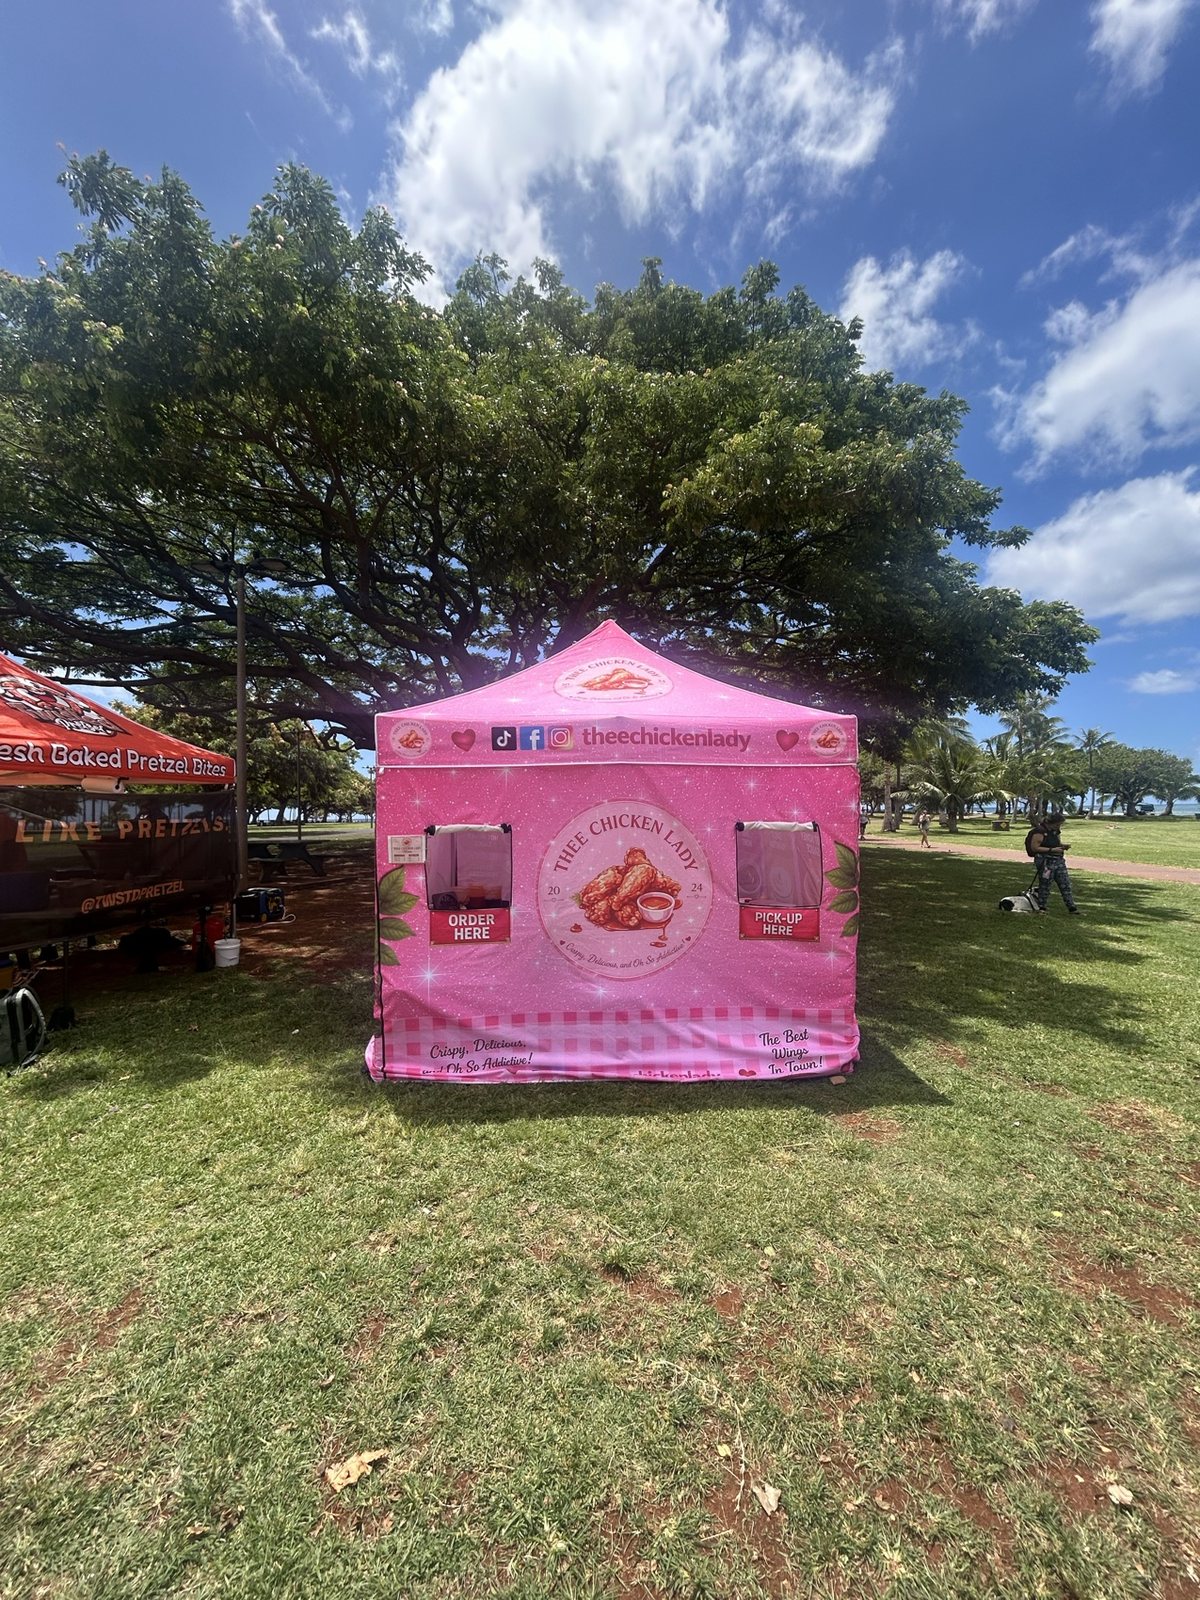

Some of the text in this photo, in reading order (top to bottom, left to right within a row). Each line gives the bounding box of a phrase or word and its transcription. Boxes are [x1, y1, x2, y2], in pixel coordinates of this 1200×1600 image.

[582, 727, 751, 752] theechickenlady
[50, 743, 122, 768] Baked
[126, 749, 189, 774] Pretzel
[192, 757, 227, 777] Bites
[15, 820, 102, 842] LIKE
[554, 813, 699, 873] THEE CHICKEN LADY
[547, 886, 560, 896] 20
[691, 883, 703, 892] 24
[81, 880, 185, 914] @TWSTDPRETZEL
[448, 913, 495, 927] ORDER
[755, 911, 803, 924] PICK-UP
[454, 927, 490, 940] HERE
[763, 924, 793, 936] HERE
[633, 958, 645, 968] Oh
[646, 955, 655, 965] So
[759, 1029, 809, 1047] The Best
[430, 1045, 469, 1059] Crispy,
[772, 1047, 809, 1060] Wings
[446, 1062, 463, 1074] Oh
[466, 1060, 480, 1073] So
[482, 1052, 533, 1070] Addictive!
[768, 1056, 823, 1074] In Town!
